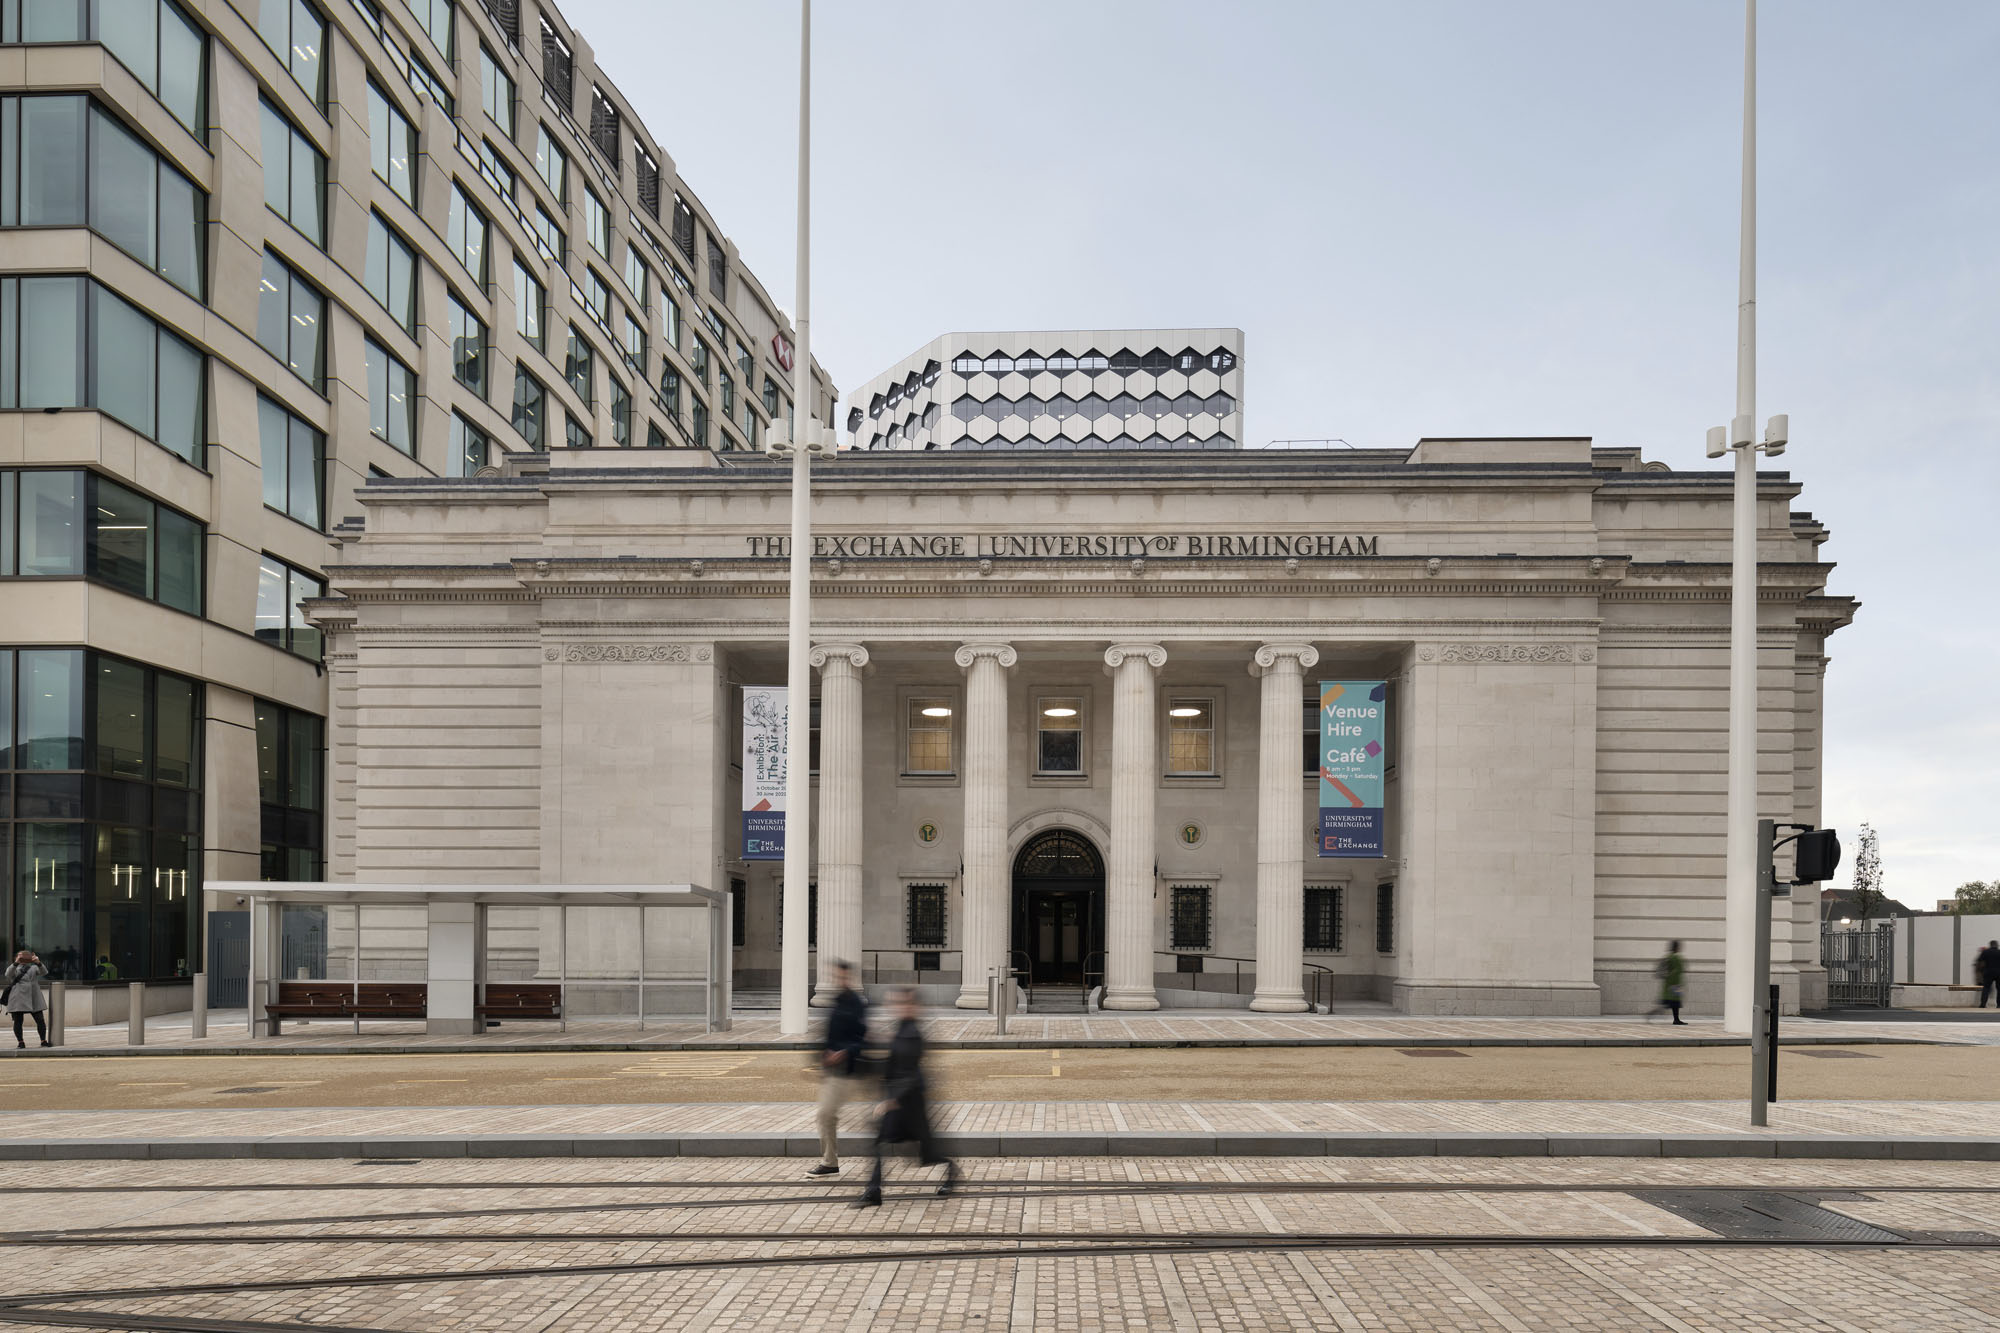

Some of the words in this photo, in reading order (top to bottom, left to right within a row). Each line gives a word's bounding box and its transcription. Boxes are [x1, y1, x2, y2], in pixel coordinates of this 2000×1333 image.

[746, 536, 792, 556] TH
[813, 536, 966, 556] EXCHANGE
[990, 536, 1156, 556] UNIVERSITY
[1155, 535, 1179, 551] OF
[1186, 536, 1379, 556] BIRMINGHAM
[1326, 705, 1377, 718] Venue
[1327, 721, 1362, 736] Hire
[769, 735, 778, 752] Air
[756, 733, 765, 780] Exhibition:
[1327, 747, 1366, 763] Café
[767, 756, 778, 780] The
[612, 1056, 758, 1077] STOP
